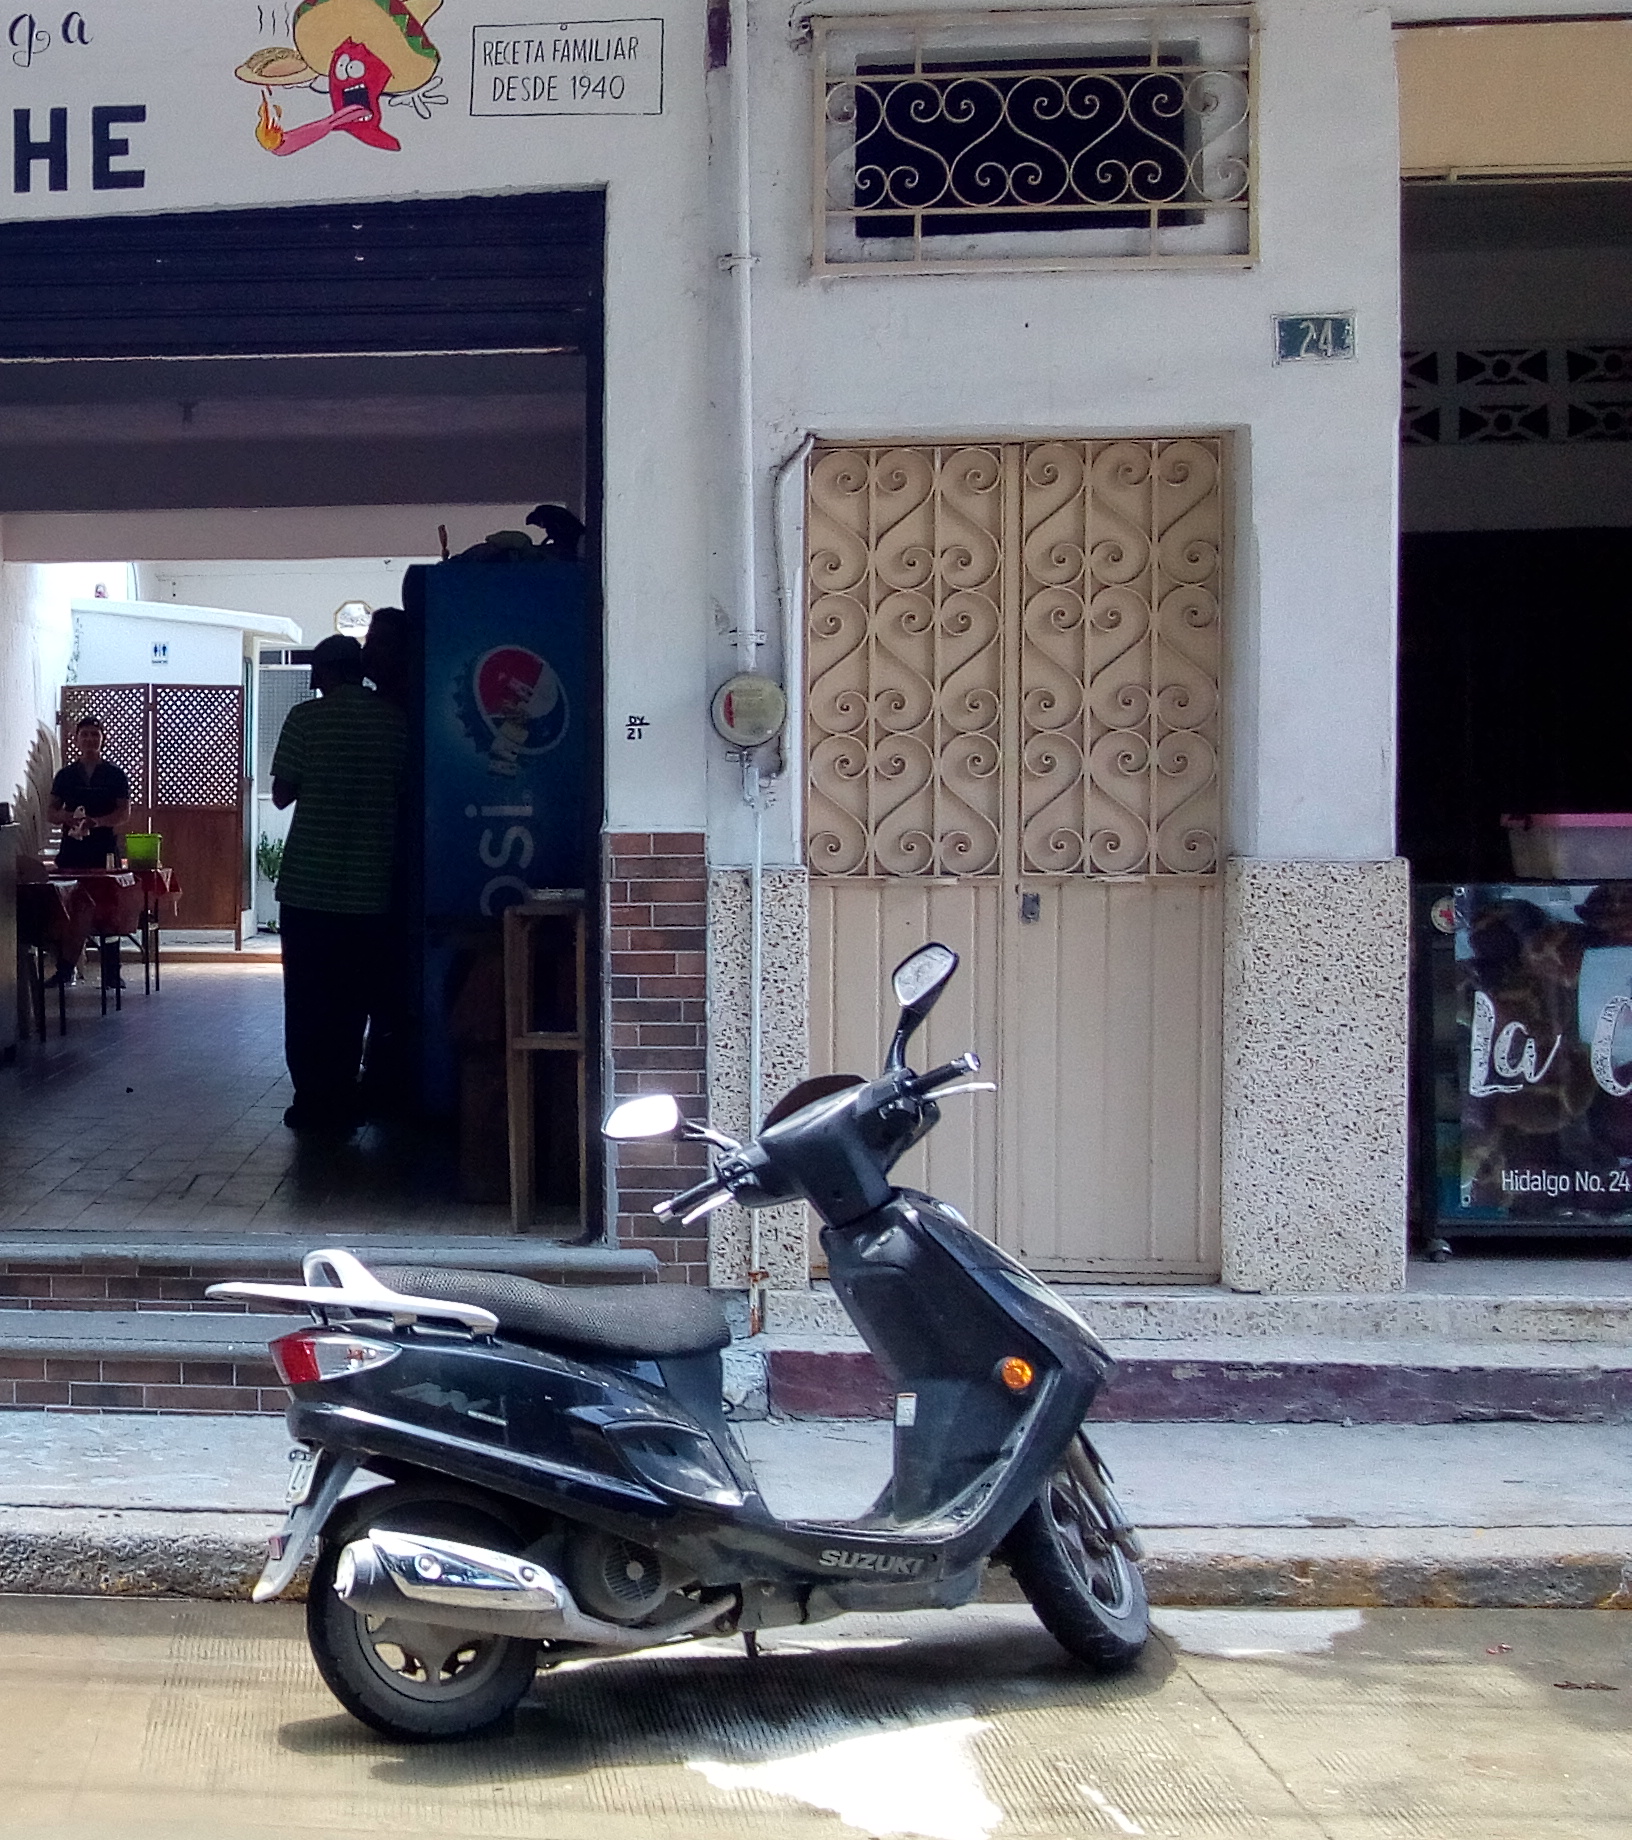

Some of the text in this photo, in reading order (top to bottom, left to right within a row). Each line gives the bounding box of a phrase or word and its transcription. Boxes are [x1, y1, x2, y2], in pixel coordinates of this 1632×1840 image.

[483, 36, 639, 67] RECETA FAMILIAR
[492, 75, 625, 102] DESDE 1940
[1299, 320, 1333, 358] 24
[1469, 990, 1562, 1096] La
[1501, 1169, 1631, 1197] Hidalgo No. 24
[819, 1549, 925, 1574] SUZUKI
